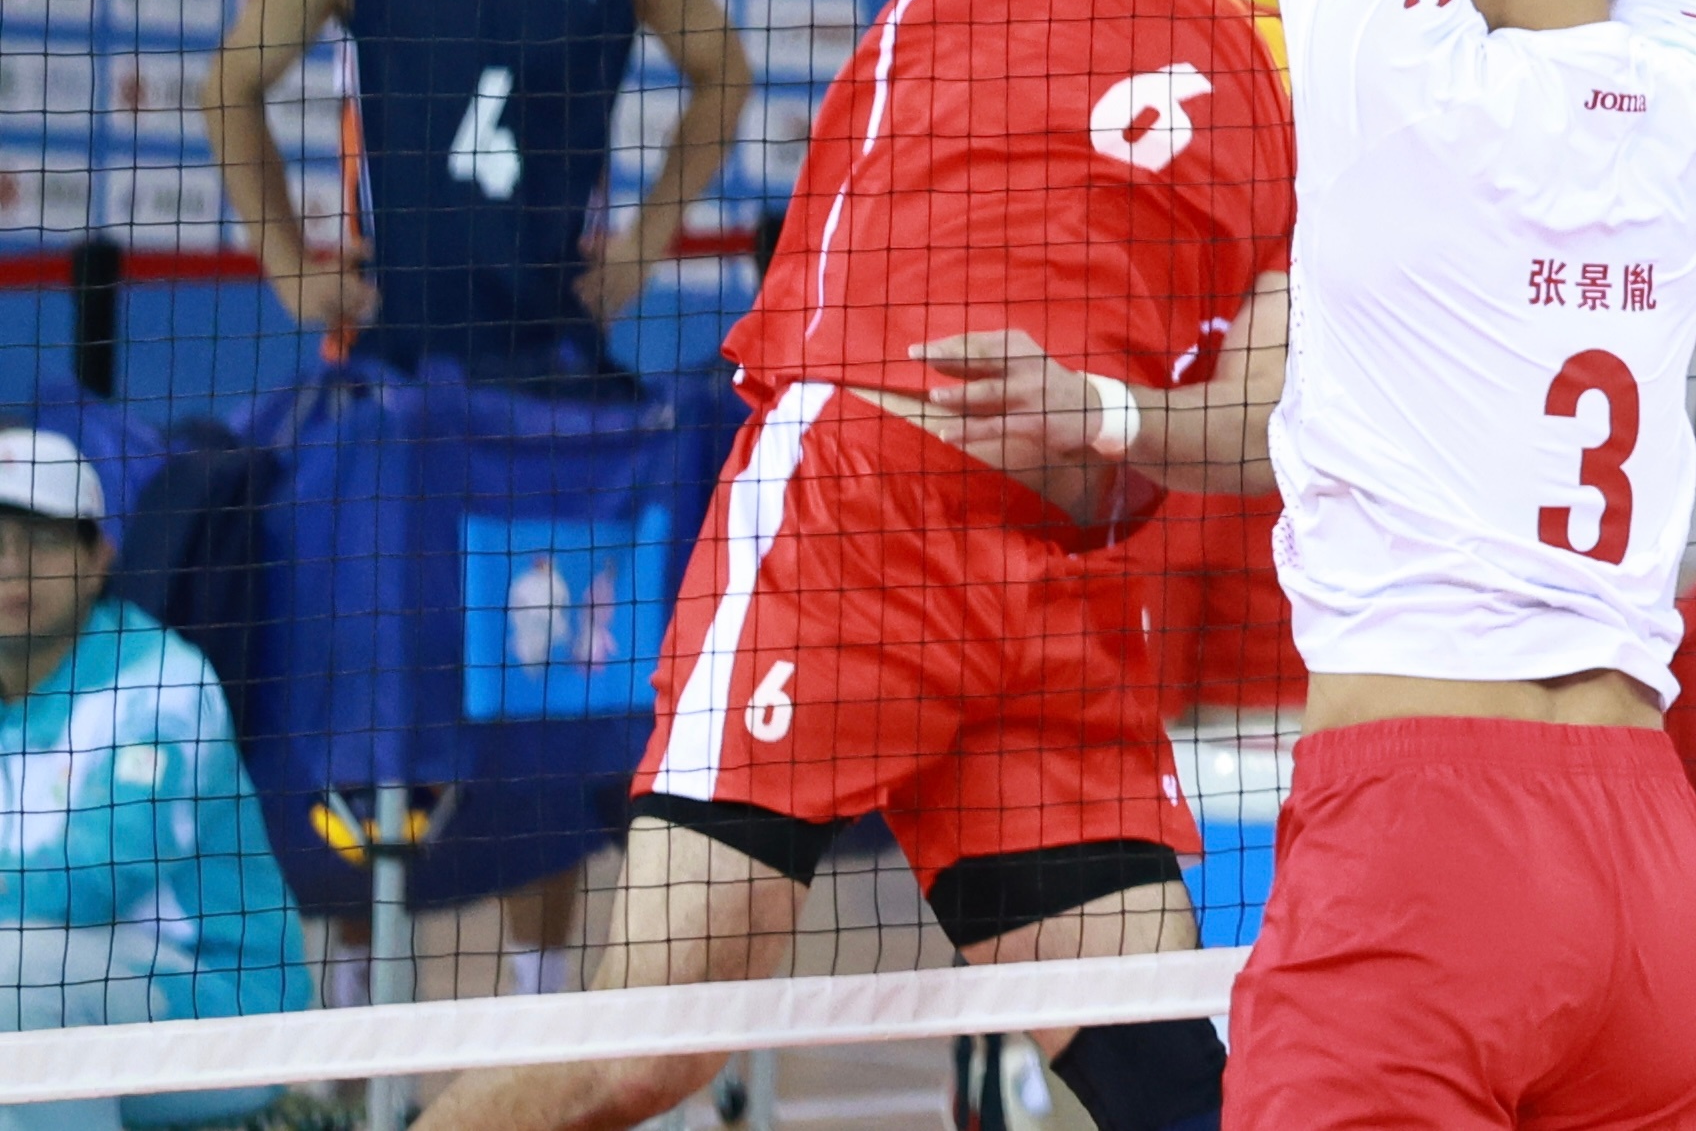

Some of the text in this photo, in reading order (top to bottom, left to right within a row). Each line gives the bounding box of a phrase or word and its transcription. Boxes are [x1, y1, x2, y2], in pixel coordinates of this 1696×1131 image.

[1088, 61, 1213, 174] 6
[1584, 89, 1647, 113] Joma
[1527, 258, 1658, 312] 张景胤
[1537, 348, 1640, 566] 3
[744, 660, 795, 743] 6
